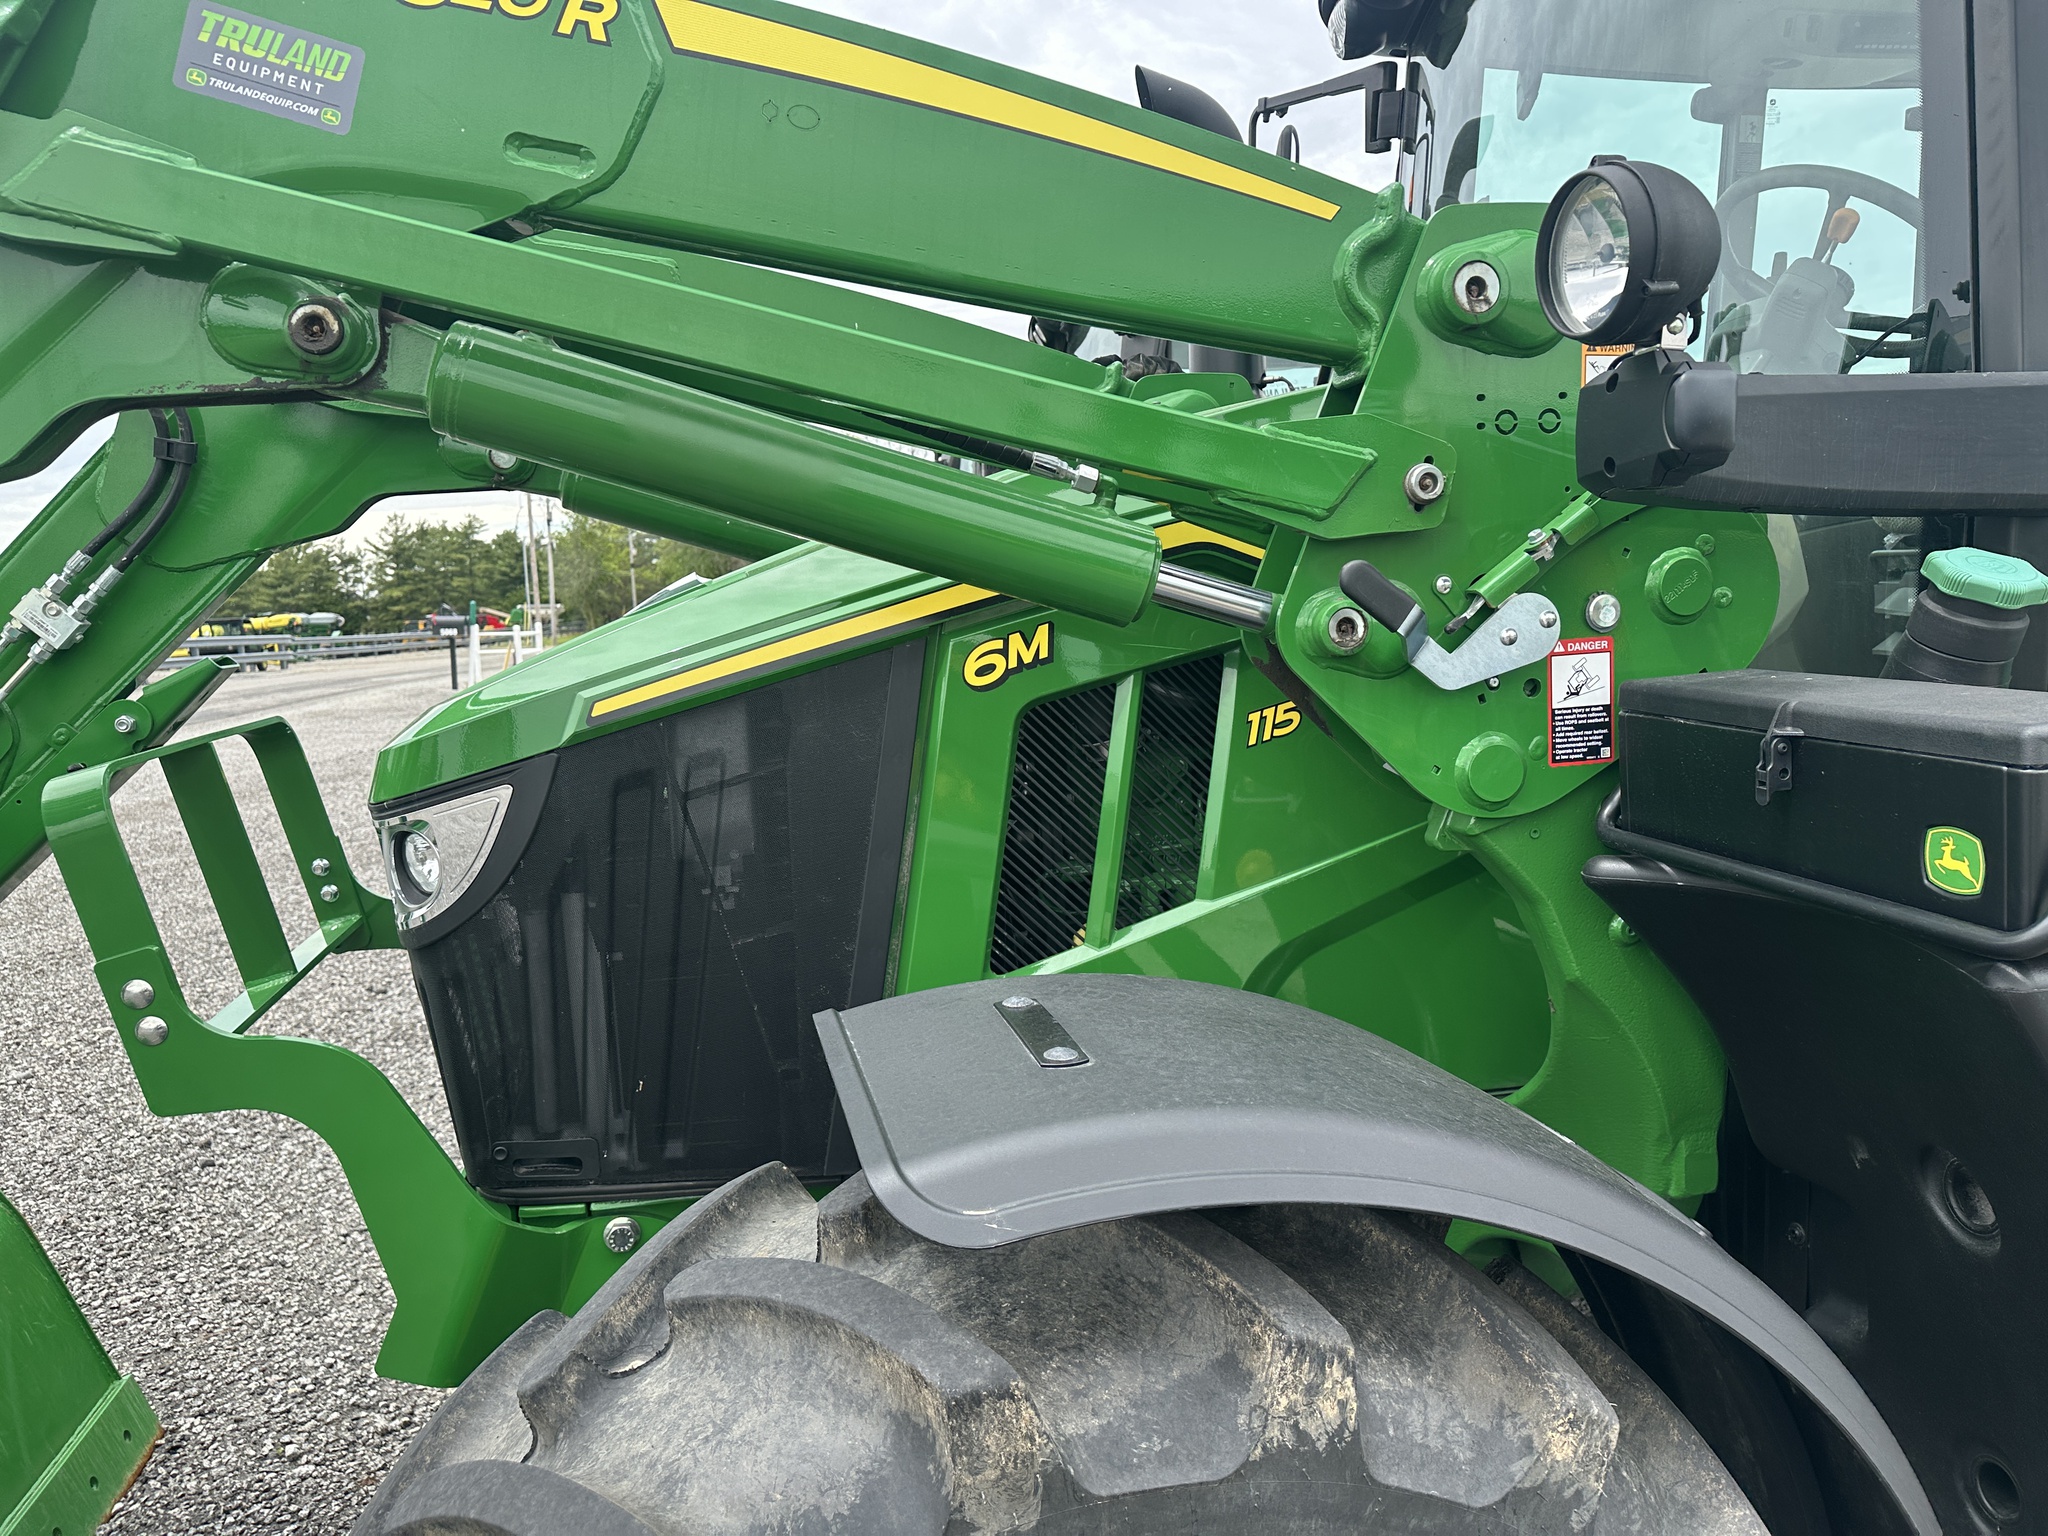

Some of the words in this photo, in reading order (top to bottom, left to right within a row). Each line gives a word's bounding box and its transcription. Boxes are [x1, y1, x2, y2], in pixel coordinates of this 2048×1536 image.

[198, 9, 352, 82] TRULAND
[212, 52, 325, 95] EQUIPMENT
[209, 77, 319, 116] TRULANDEQUIP.COM
[962, 620, 1054, 692] 6M
[1567, 640, 1608, 652] DANGER
[1246, 700, 1302, 748] 115
